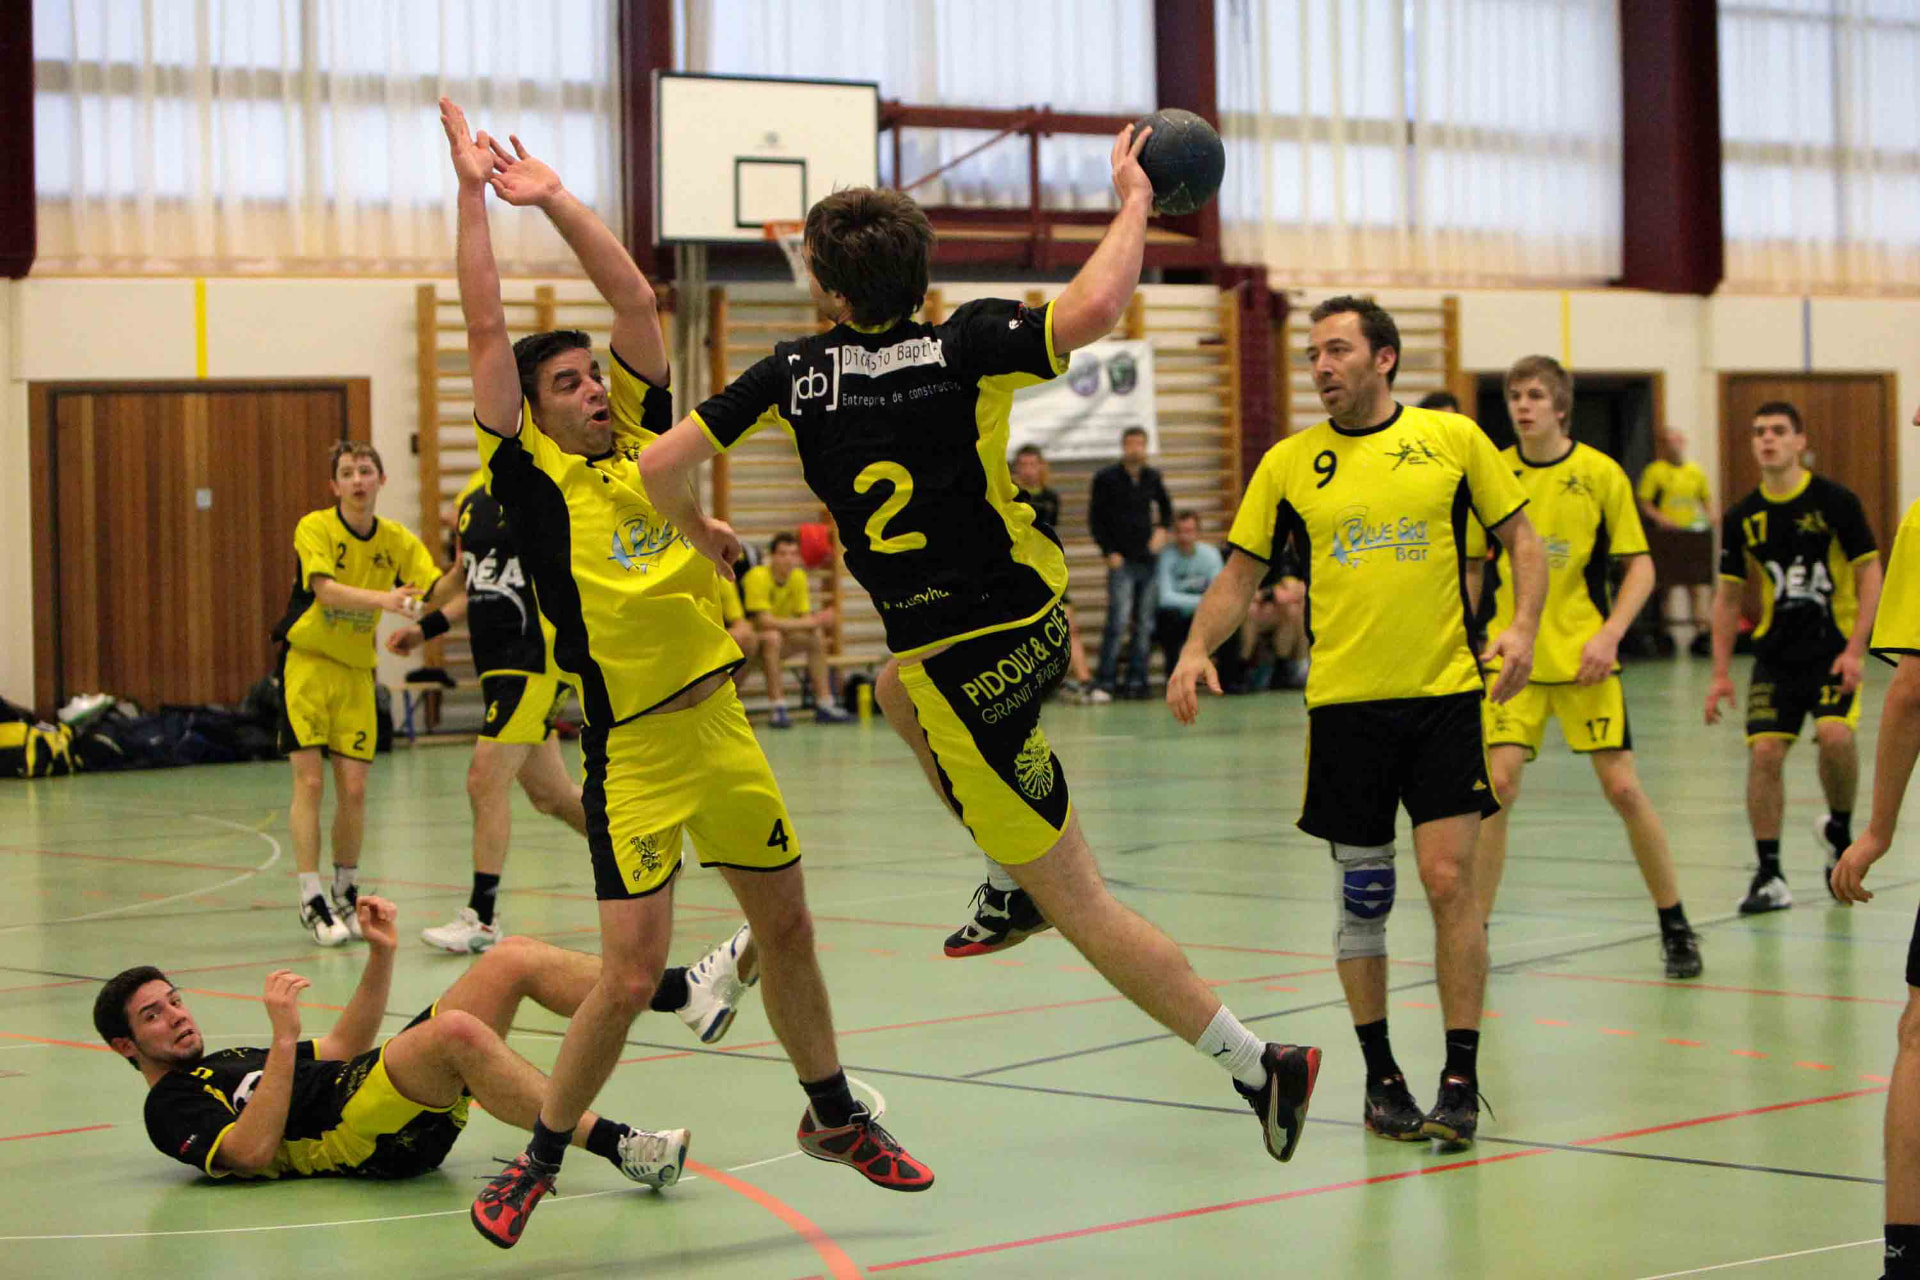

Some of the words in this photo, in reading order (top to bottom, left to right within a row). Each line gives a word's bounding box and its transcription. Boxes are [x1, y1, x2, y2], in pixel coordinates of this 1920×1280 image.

[892, 390, 903, 403] de
[1314, 450, 1337, 489] 9
[459, 503, 473, 534] 6
[853, 461, 929, 554] 2
[1742, 511, 1768, 546] 17
[336, 542, 347, 569] 2
[961, 643, 1040, 706] PIDOUX
[1029, 637, 1051, 661] &
[486, 700, 499, 723] 6
[981, 682, 1034, 725] GRANIT
[353, 731, 367, 751] 2
[1586, 716, 1611, 743] 17
[766, 818, 789, 853] 4
